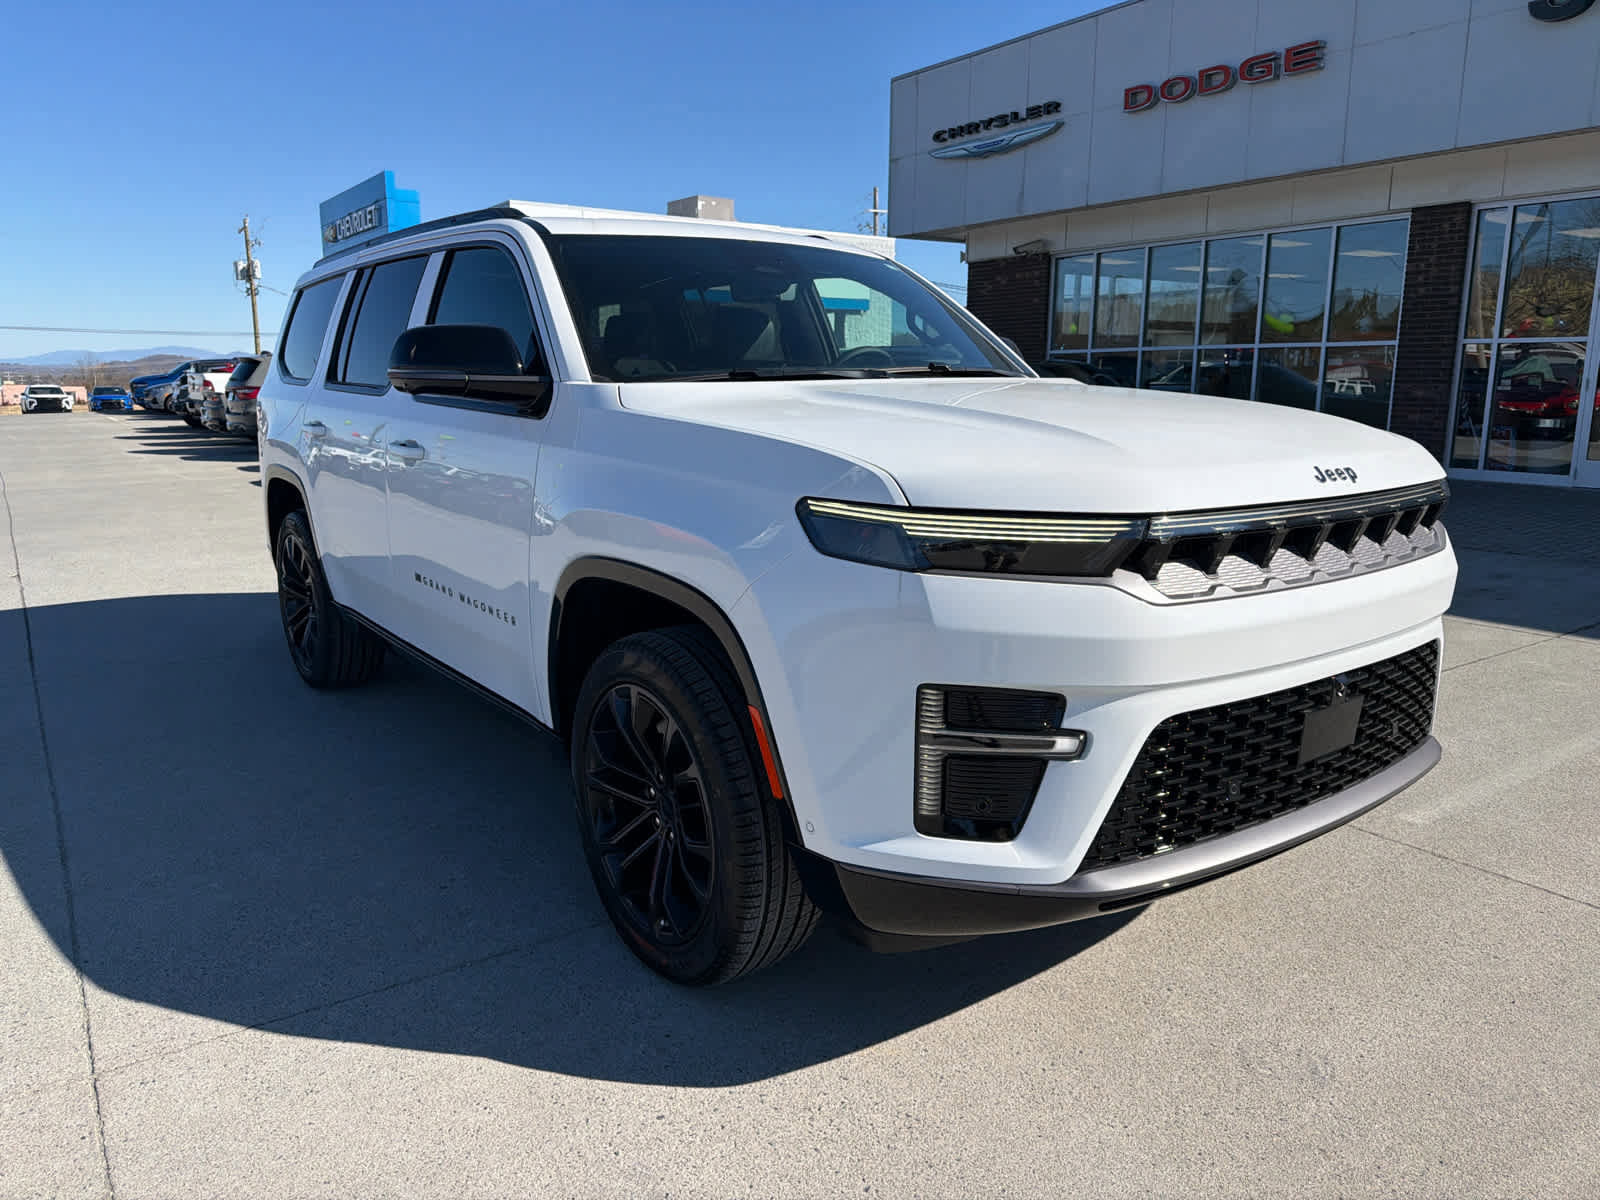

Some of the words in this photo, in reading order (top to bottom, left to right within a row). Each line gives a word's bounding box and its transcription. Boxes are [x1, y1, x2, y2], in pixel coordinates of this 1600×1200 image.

[1123, 40, 1327, 112] DODGE
[932, 101, 1062, 143] CHRYSLER
[336, 204, 378, 240] CHEVROLET
[1313, 466, 1358, 483] Jeep
[423, 576, 453, 597] GRAND
[459, 592, 516, 626] WAGONEER
